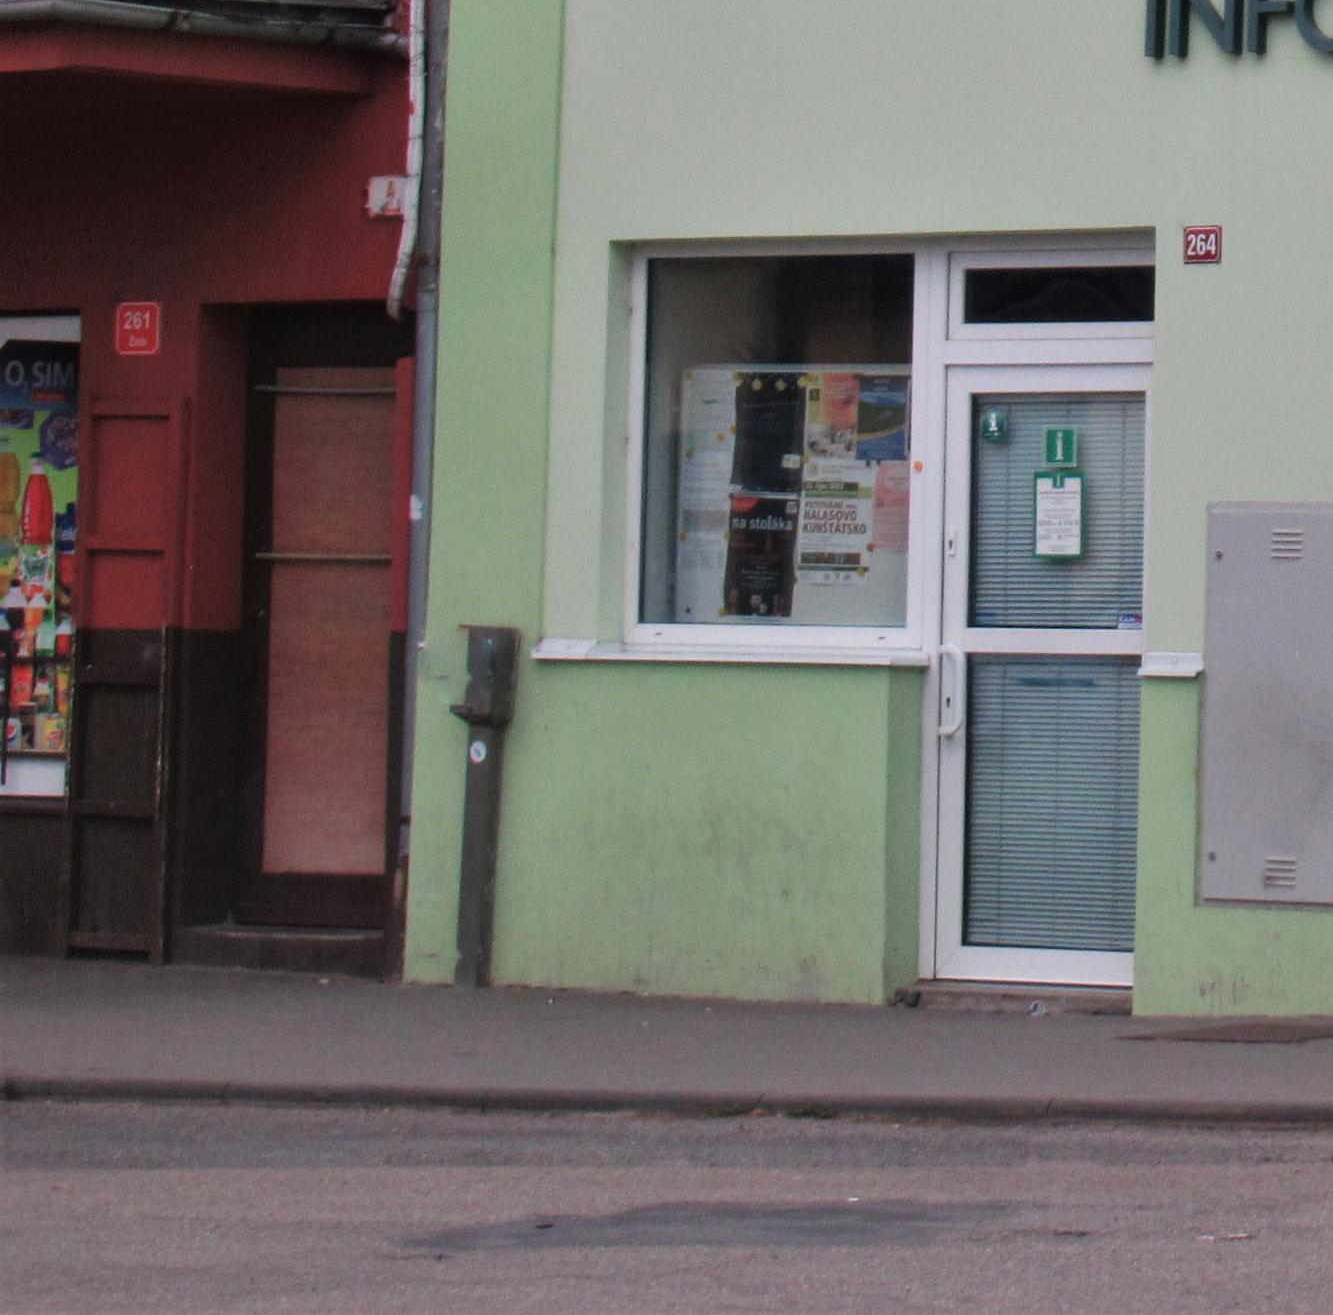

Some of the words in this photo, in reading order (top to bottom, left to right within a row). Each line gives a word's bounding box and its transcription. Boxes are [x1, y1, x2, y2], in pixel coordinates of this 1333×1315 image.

[1187, 233, 1217, 255] 264
[124, 311, 150, 330] 261
[32, 361, 76, 388] SIM
